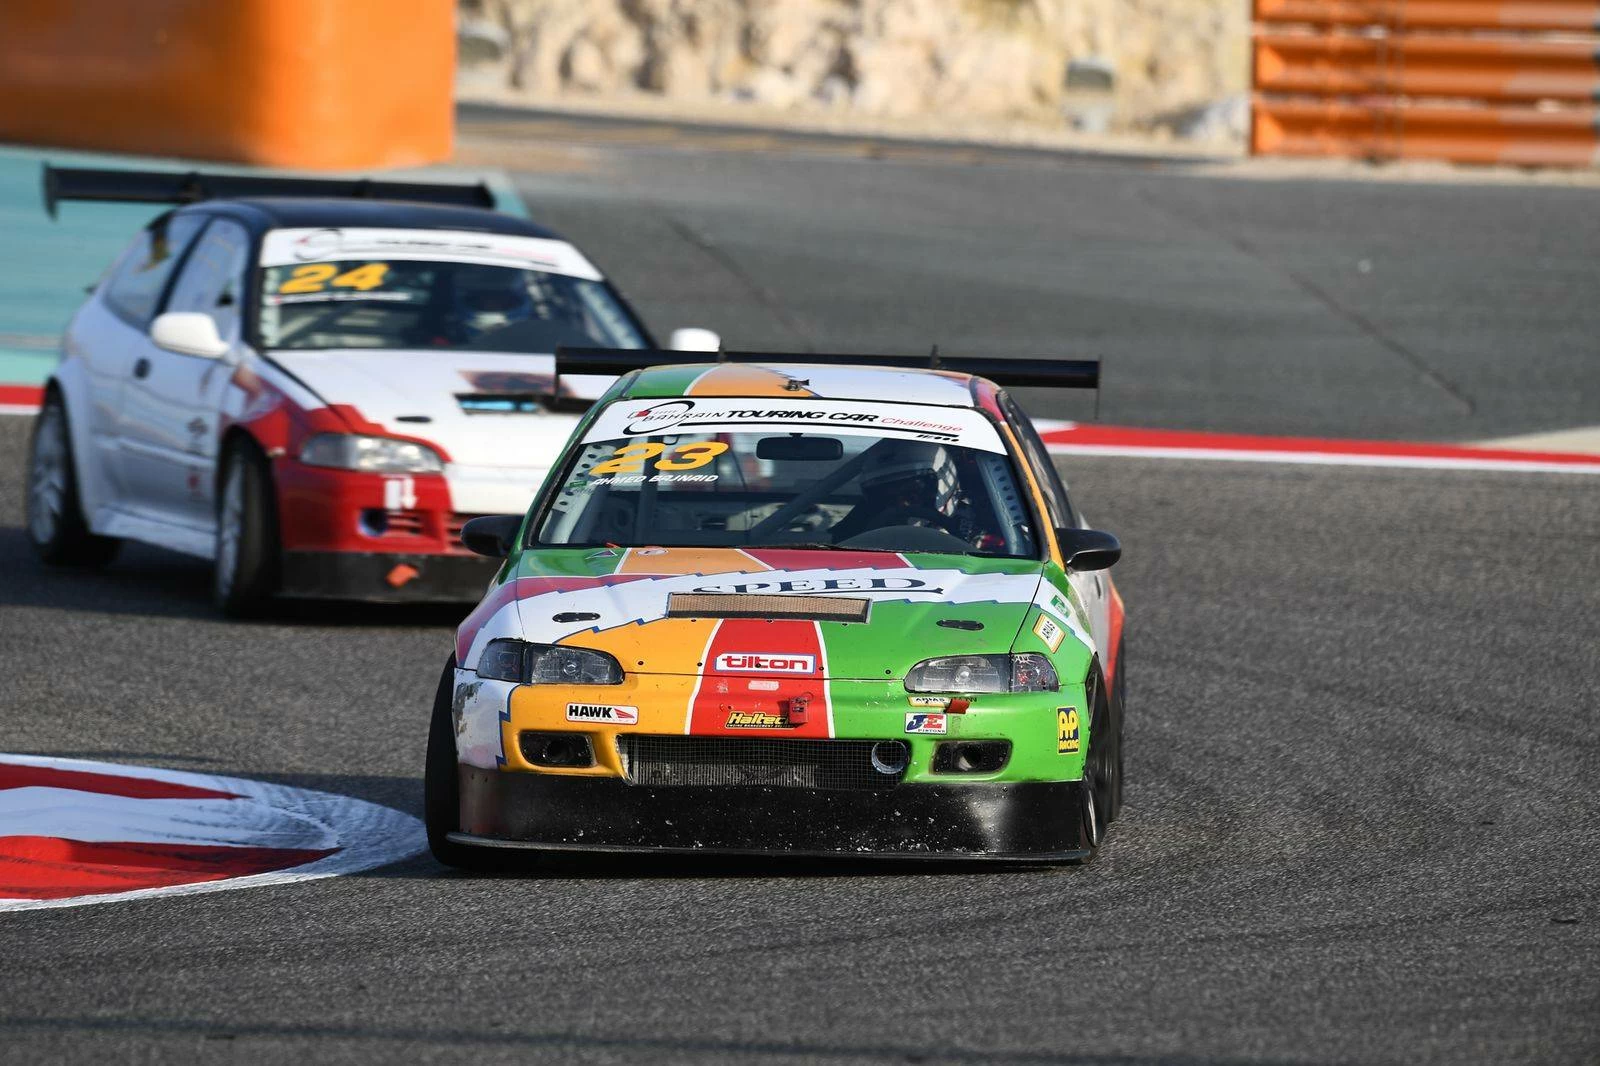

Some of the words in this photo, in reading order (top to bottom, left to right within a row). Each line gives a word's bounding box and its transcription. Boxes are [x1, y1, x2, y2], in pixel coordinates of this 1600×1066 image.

[279, 263, 389, 293] 24
[643, 411, 725, 422] BAHRAIN
[727, 409, 826, 419] TOURING
[828, 412, 879, 422] CAR
[881, 417, 963, 432] Challenge
[588, 441, 729, 476] 23
[590, 475, 647, 486] AHMED
[722, 655, 808, 670] tilton
[568, 705, 613, 719] HAWK
[728, 713, 790, 725] Haltec
[906, 714, 944, 731] JE
[1059, 710, 1079, 740] AP
